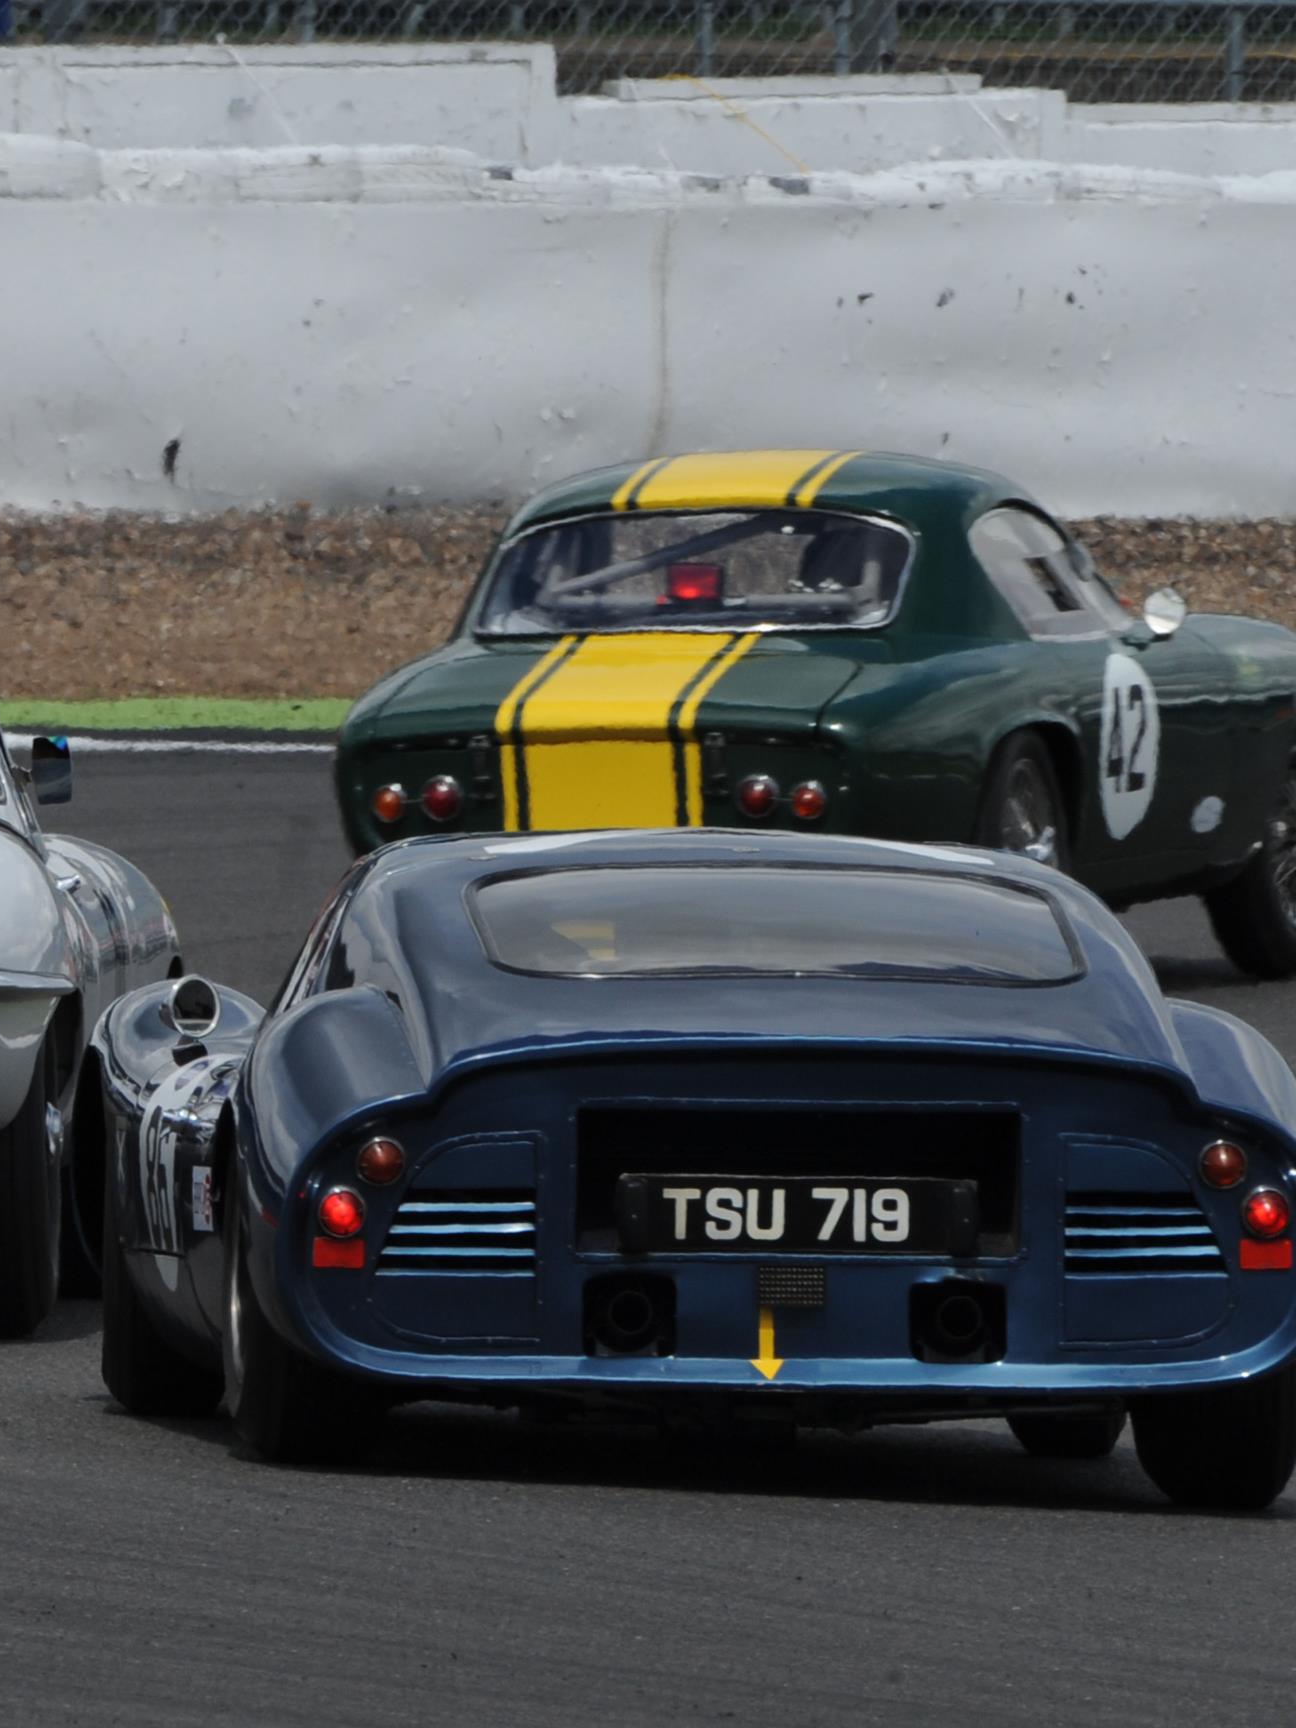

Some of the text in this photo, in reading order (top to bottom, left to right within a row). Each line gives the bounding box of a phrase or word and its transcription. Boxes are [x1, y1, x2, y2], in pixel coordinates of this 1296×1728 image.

[1106, 684, 1146, 793] 42
[662, 1187, 910, 1242] TSU 719
